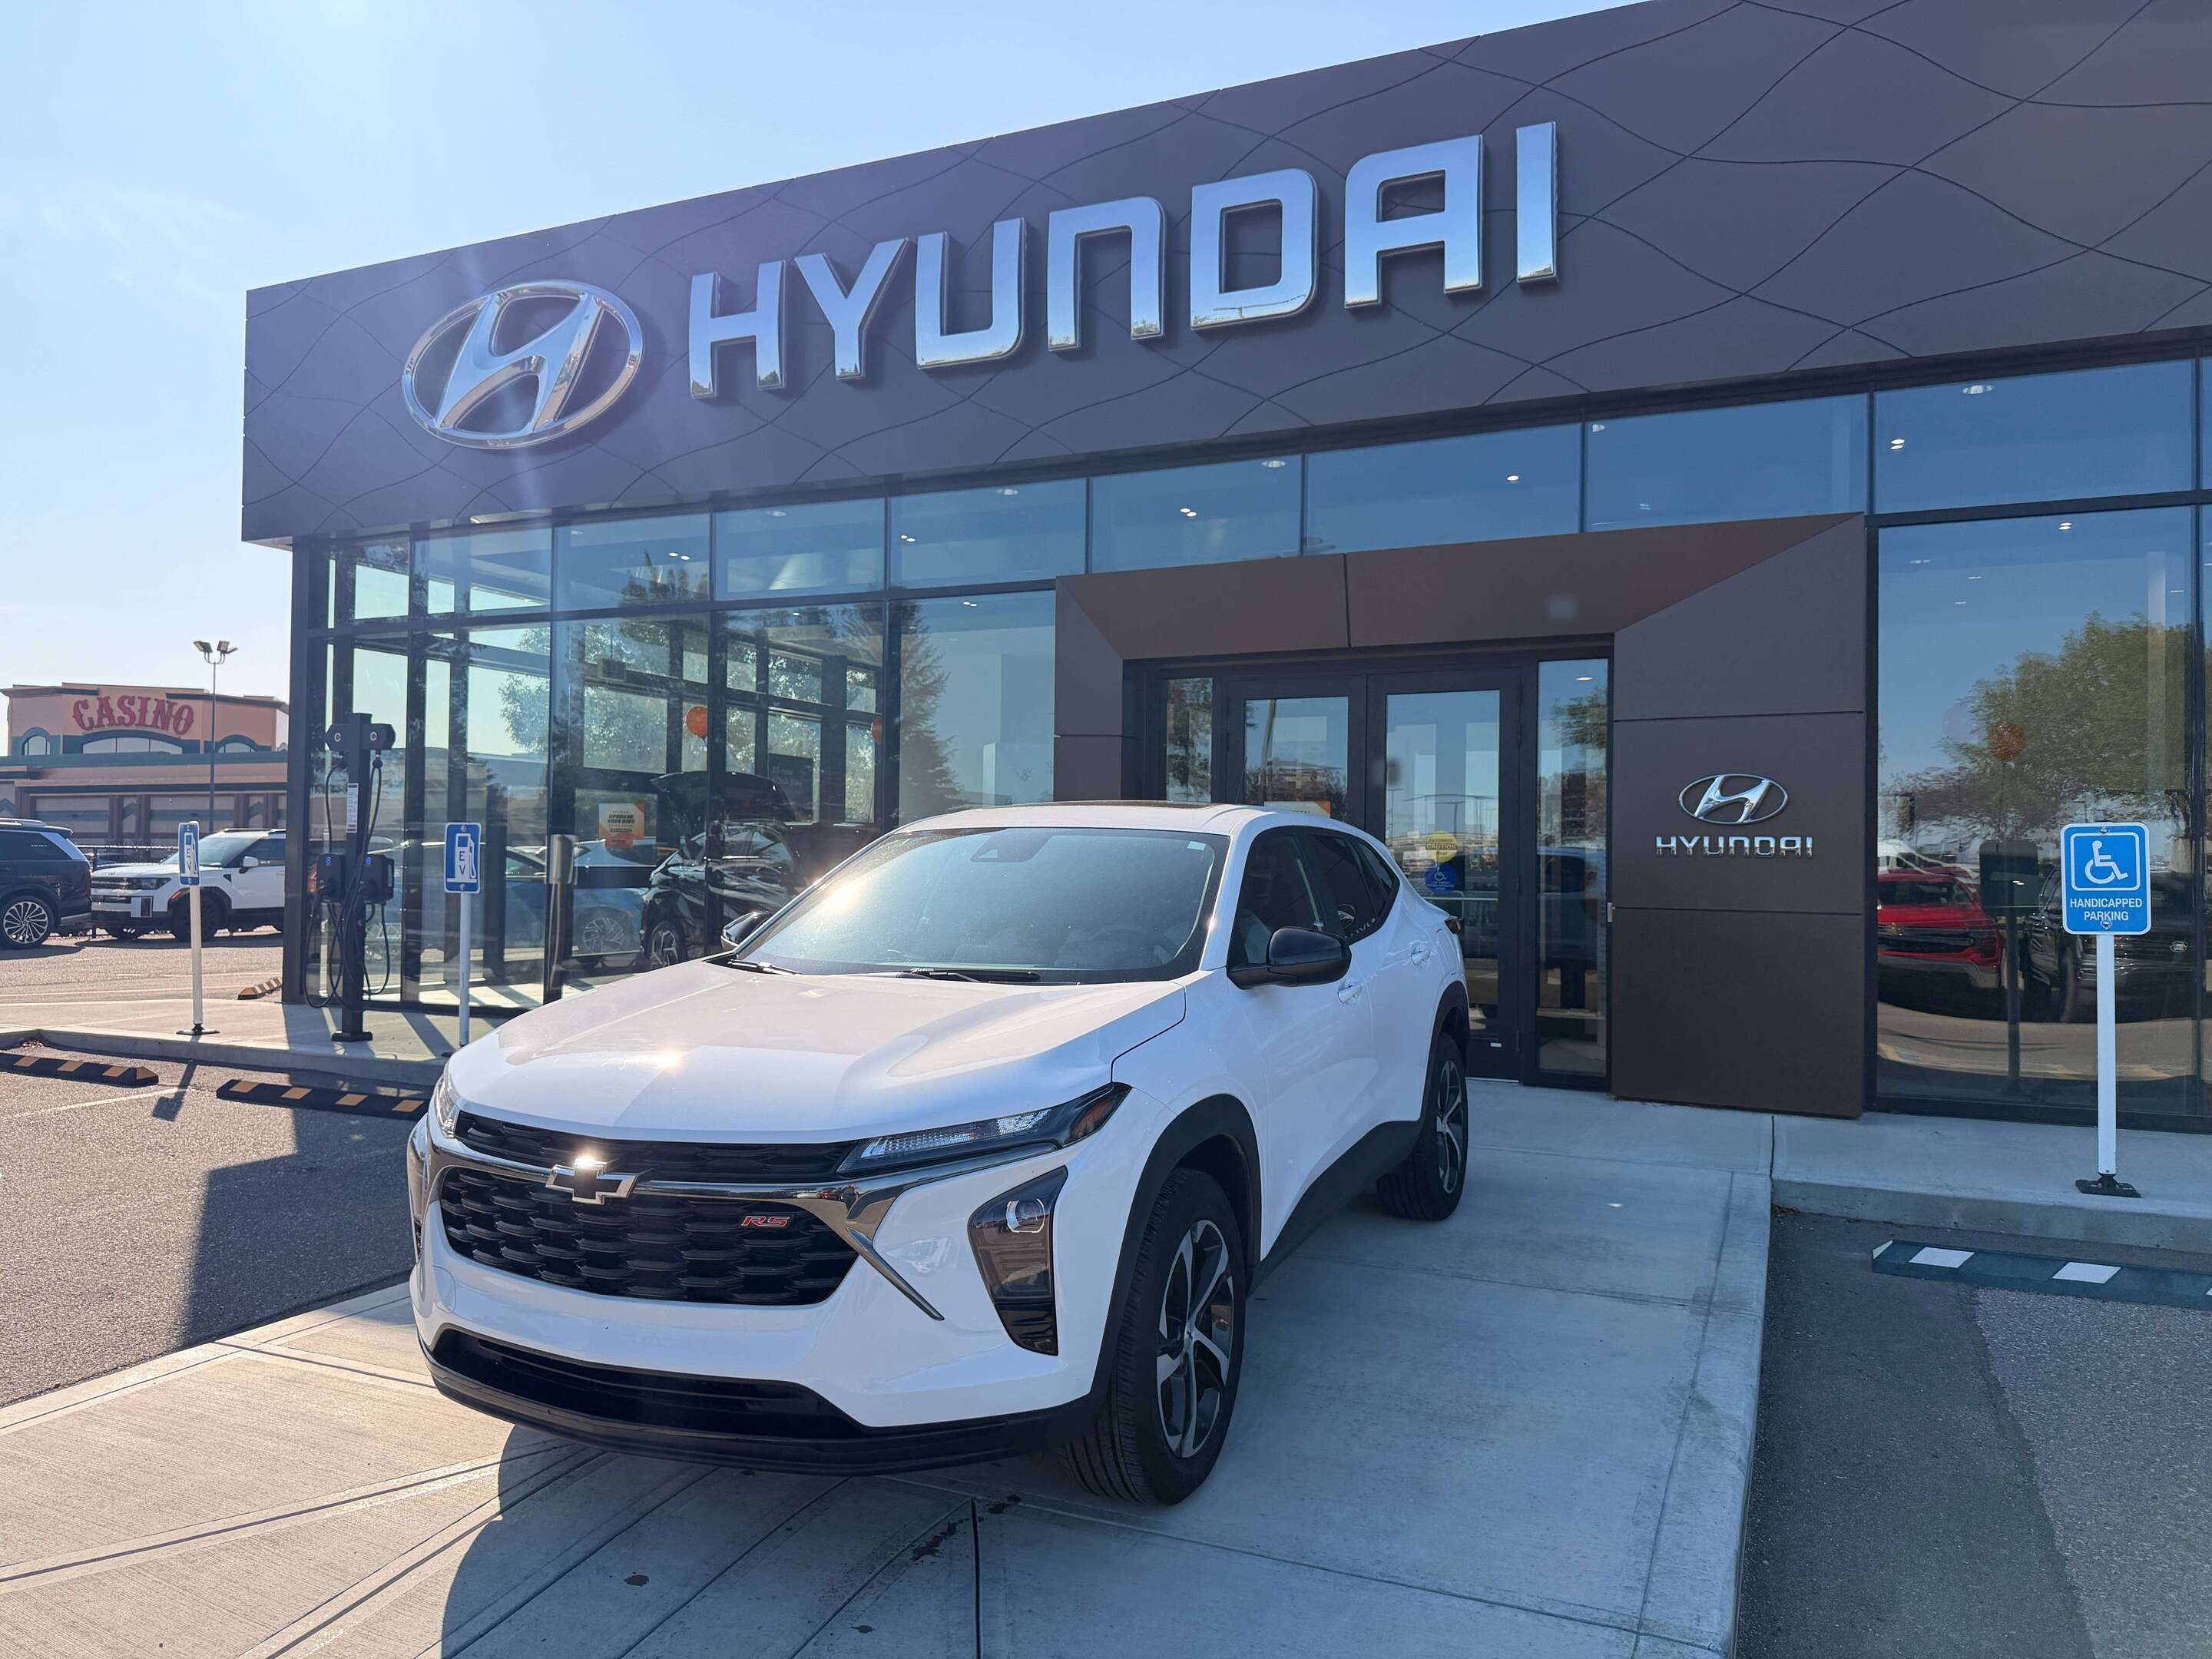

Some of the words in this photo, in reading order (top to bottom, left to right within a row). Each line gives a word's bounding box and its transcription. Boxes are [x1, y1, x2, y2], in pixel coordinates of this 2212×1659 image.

[688, 121, 1558, 399] HYUNDAI
[72, 695, 194, 735] CASINO
[1656, 836, 1813, 857] HYUNDAI
[2070, 898, 2143, 908] HANDICAPPED
[2084, 911, 2129, 921] PARKING
[740, 1216, 790, 1227] RS
